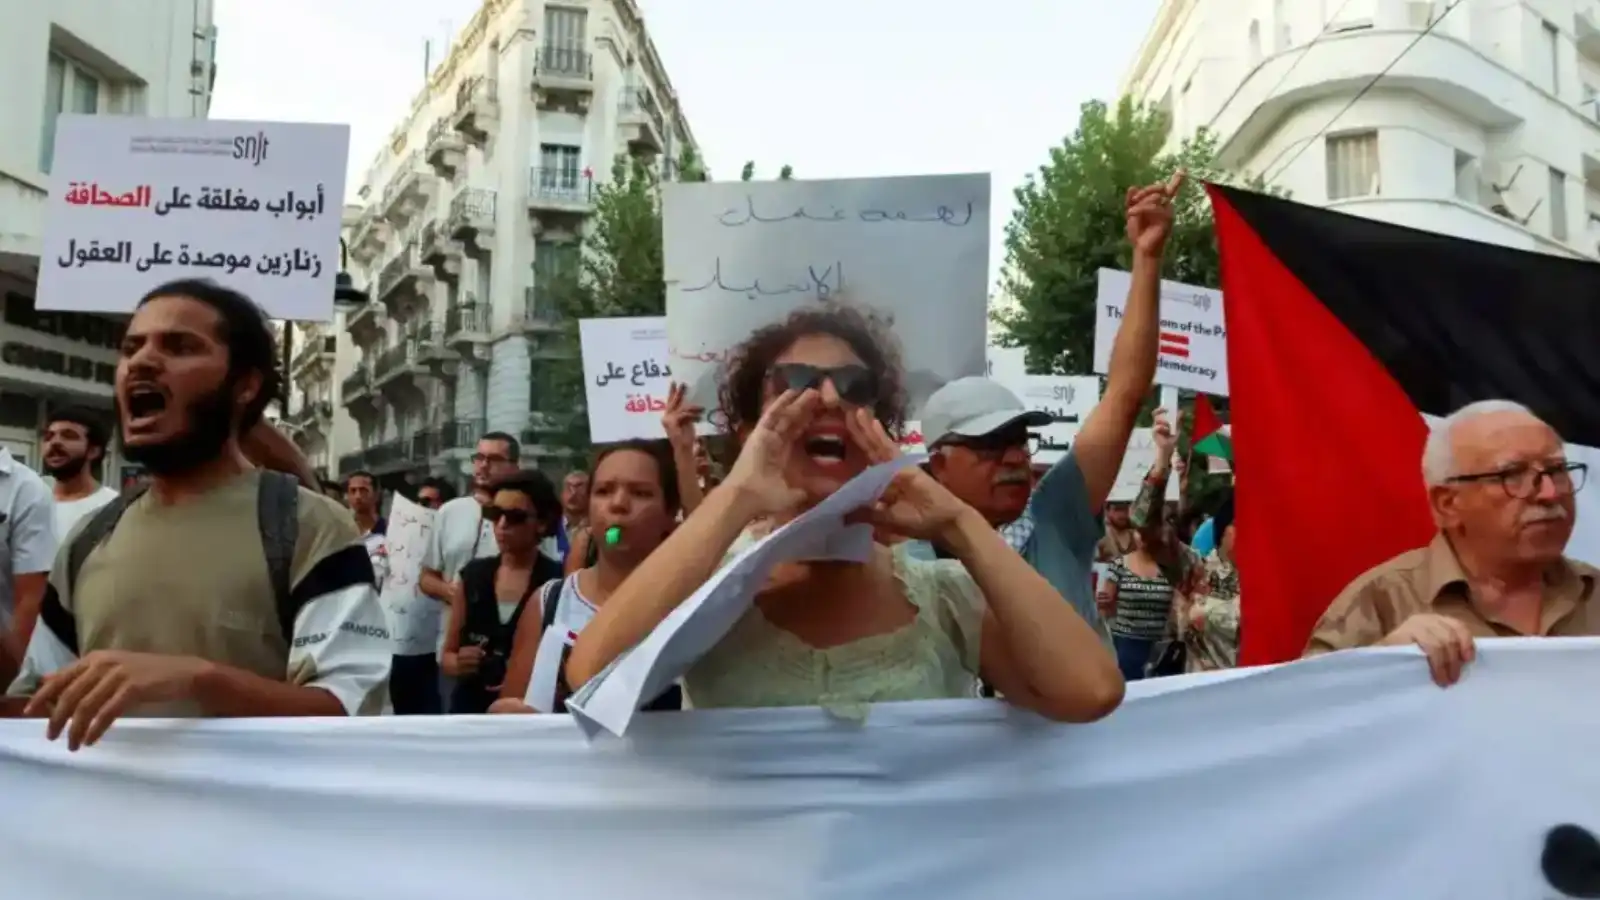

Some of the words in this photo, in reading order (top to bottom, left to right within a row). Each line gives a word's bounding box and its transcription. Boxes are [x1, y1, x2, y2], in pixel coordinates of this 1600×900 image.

[232, 131, 269, 166] snjt
[65, 181, 151, 207] الصحافة
[155, 186, 191, 216] على
[197, 186, 260, 212] مغلقة
[266, 183, 324, 220] أبواب
[58, 238, 132, 268] العقول
[136, 241, 173, 272] على
[178, 244, 251, 274] موصدة
[255, 247, 322, 278] زنازين
[1105, 304, 1125, 319] Th
[596, 361, 626, 387] على
